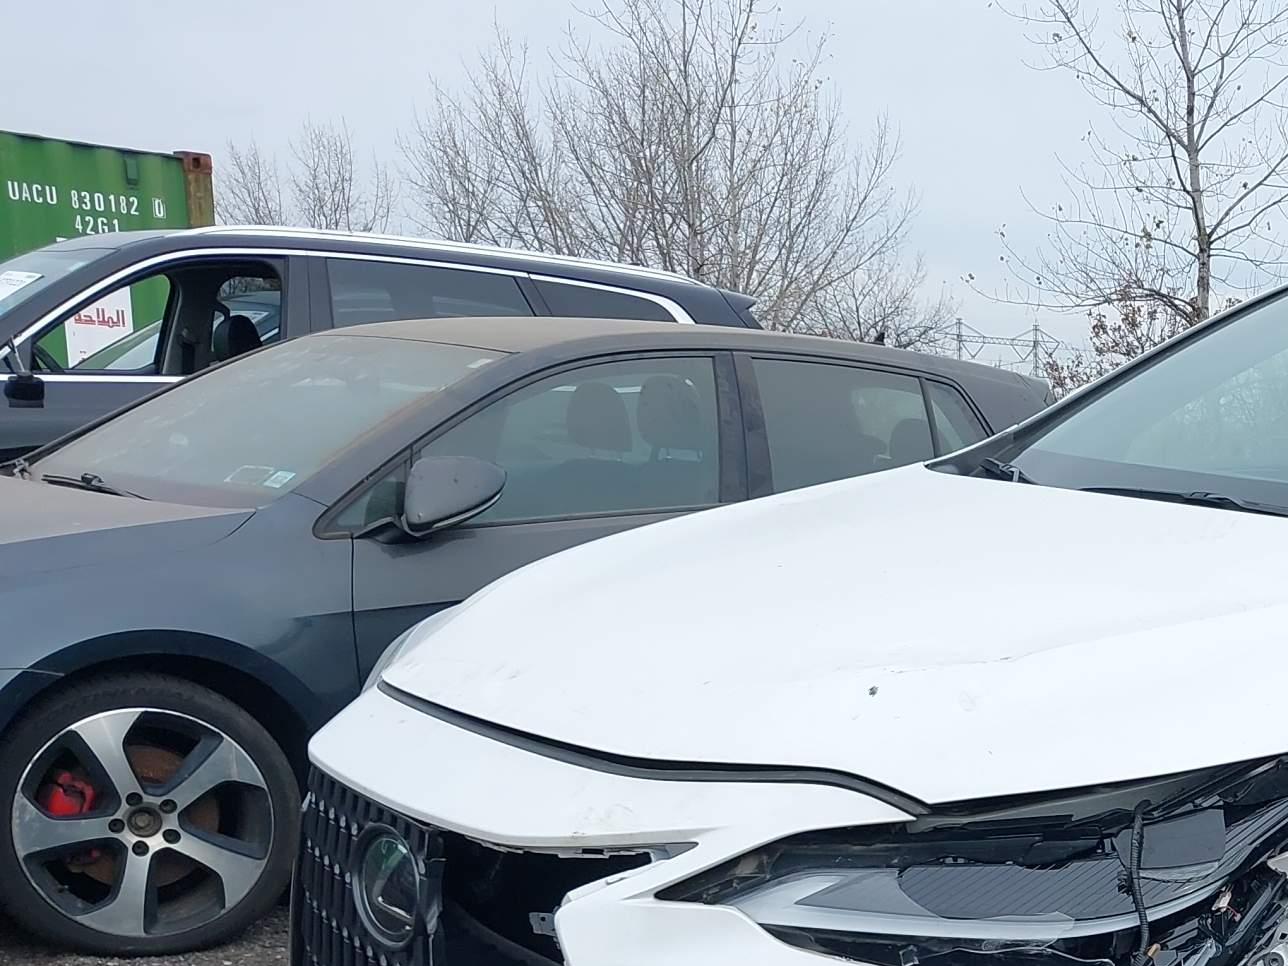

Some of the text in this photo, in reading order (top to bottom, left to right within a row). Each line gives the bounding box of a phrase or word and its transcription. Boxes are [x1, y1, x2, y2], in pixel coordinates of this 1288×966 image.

[8, 180, 57, 205] UACU
[71, 190, 139, 216] 830182
[75, 215, 120, 234] 42G1
